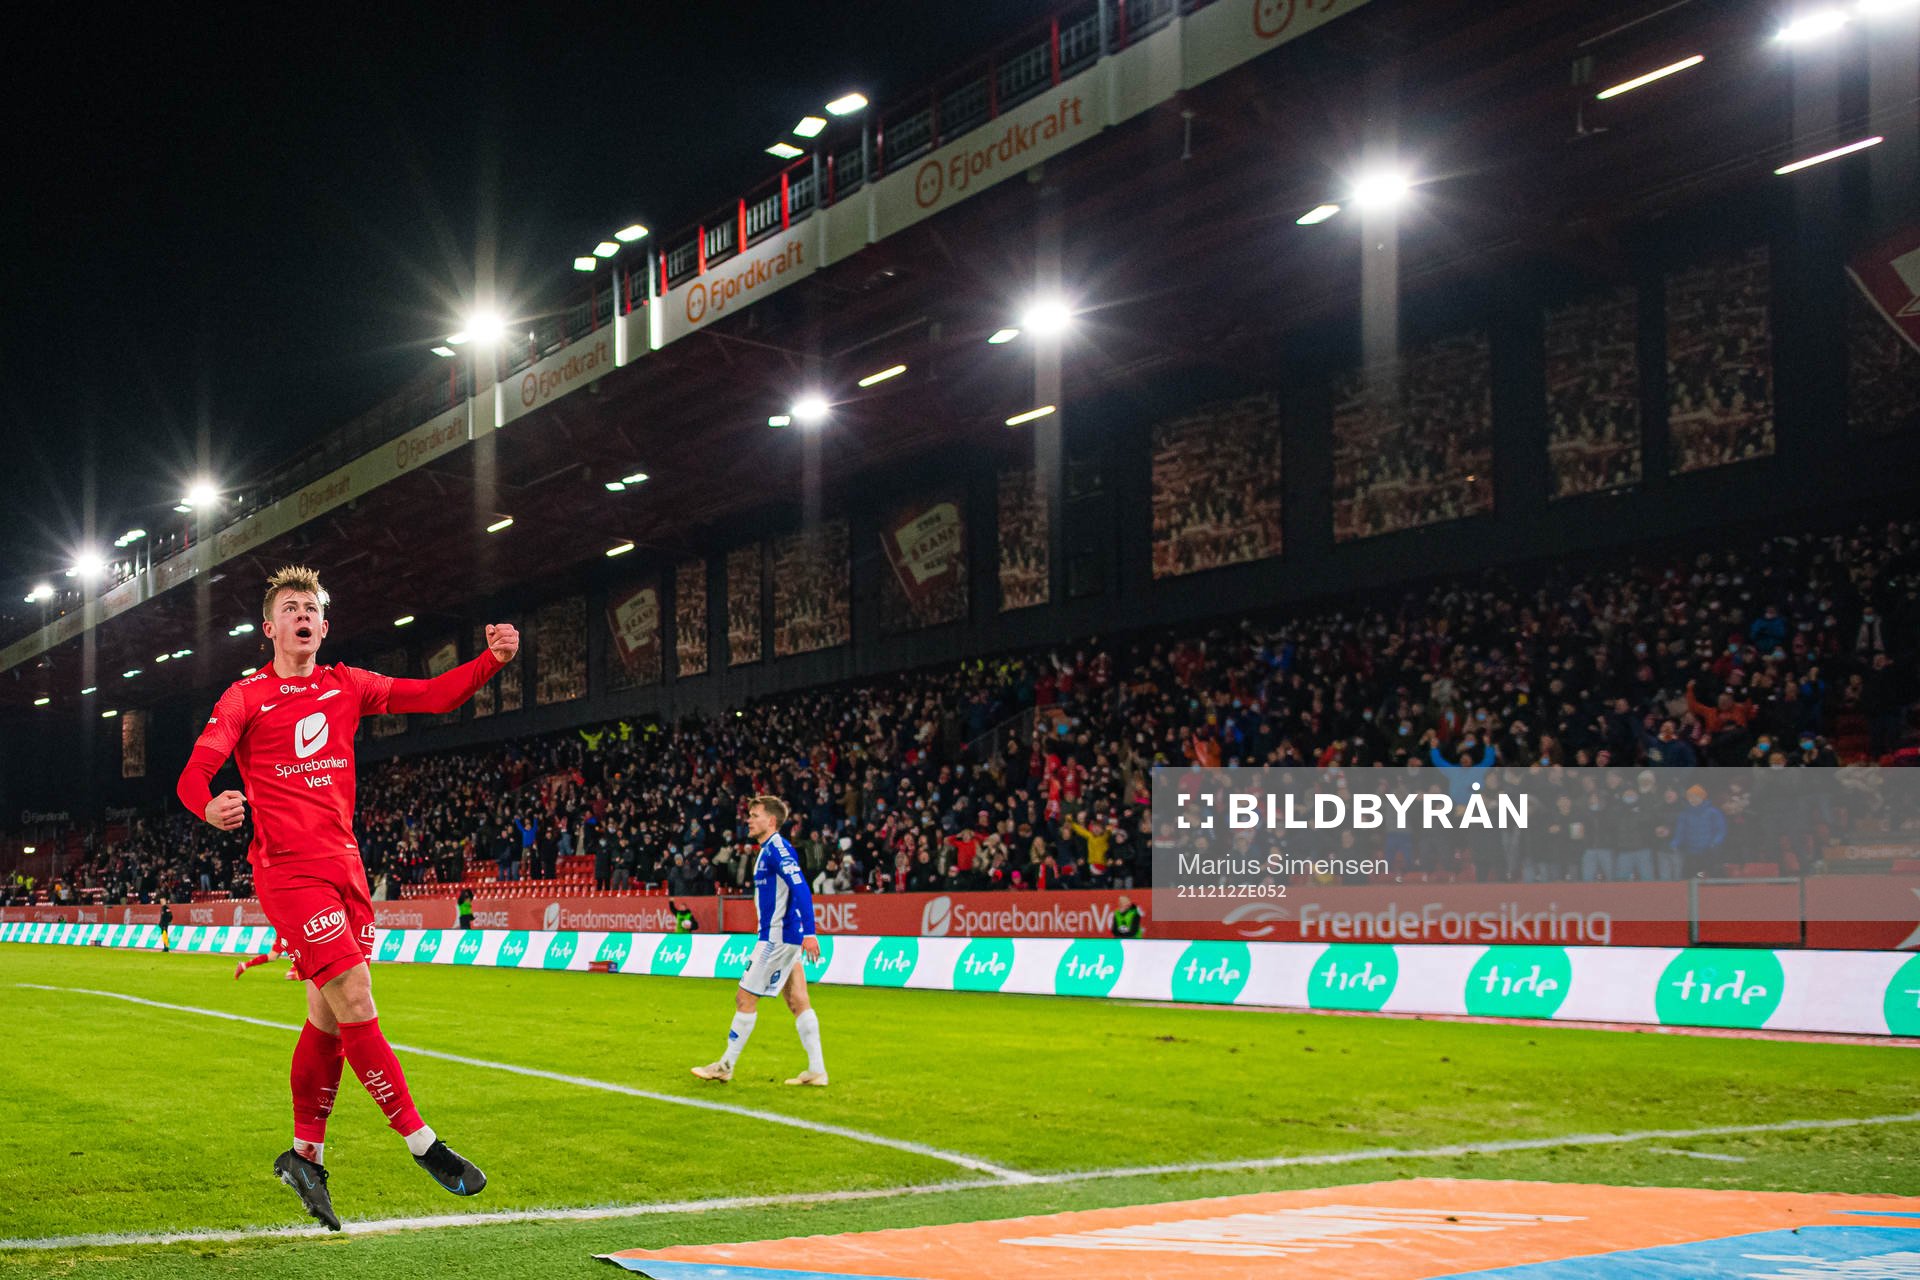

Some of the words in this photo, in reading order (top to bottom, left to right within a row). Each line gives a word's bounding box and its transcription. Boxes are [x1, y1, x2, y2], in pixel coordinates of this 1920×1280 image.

[949, 96, 1083, 191] Fjordkraft
[710, 240, 804, 311] Fjordkraft
[538, 344, 608, 397] Fjordkraft
[275, 756, 348, 778] Sparebanken
[304, 774, 333, 789] Vest
[303, 910, 345, 937] LERØY
[813, 902, 858, 931] RNE
[954, 903, 1145, 937] SparebankenV
[1300, 901, 1612, 945] FrendeForsikring
[551, 941, 572, 959] tide
[602, 943, 626, 960] tide
[659, 944, 687, 963] tide
[873, 950, 911, 973] tide
[963, 952, 1006, 976] tide
[1065, 954, 1115, 980] tide
[1183, 957, 1241, 986] tide
[1321, 961, 1387, 992] tide
[1479, 964, 1558, 998] tide
[1671, 969, 1767, 1005] tide
